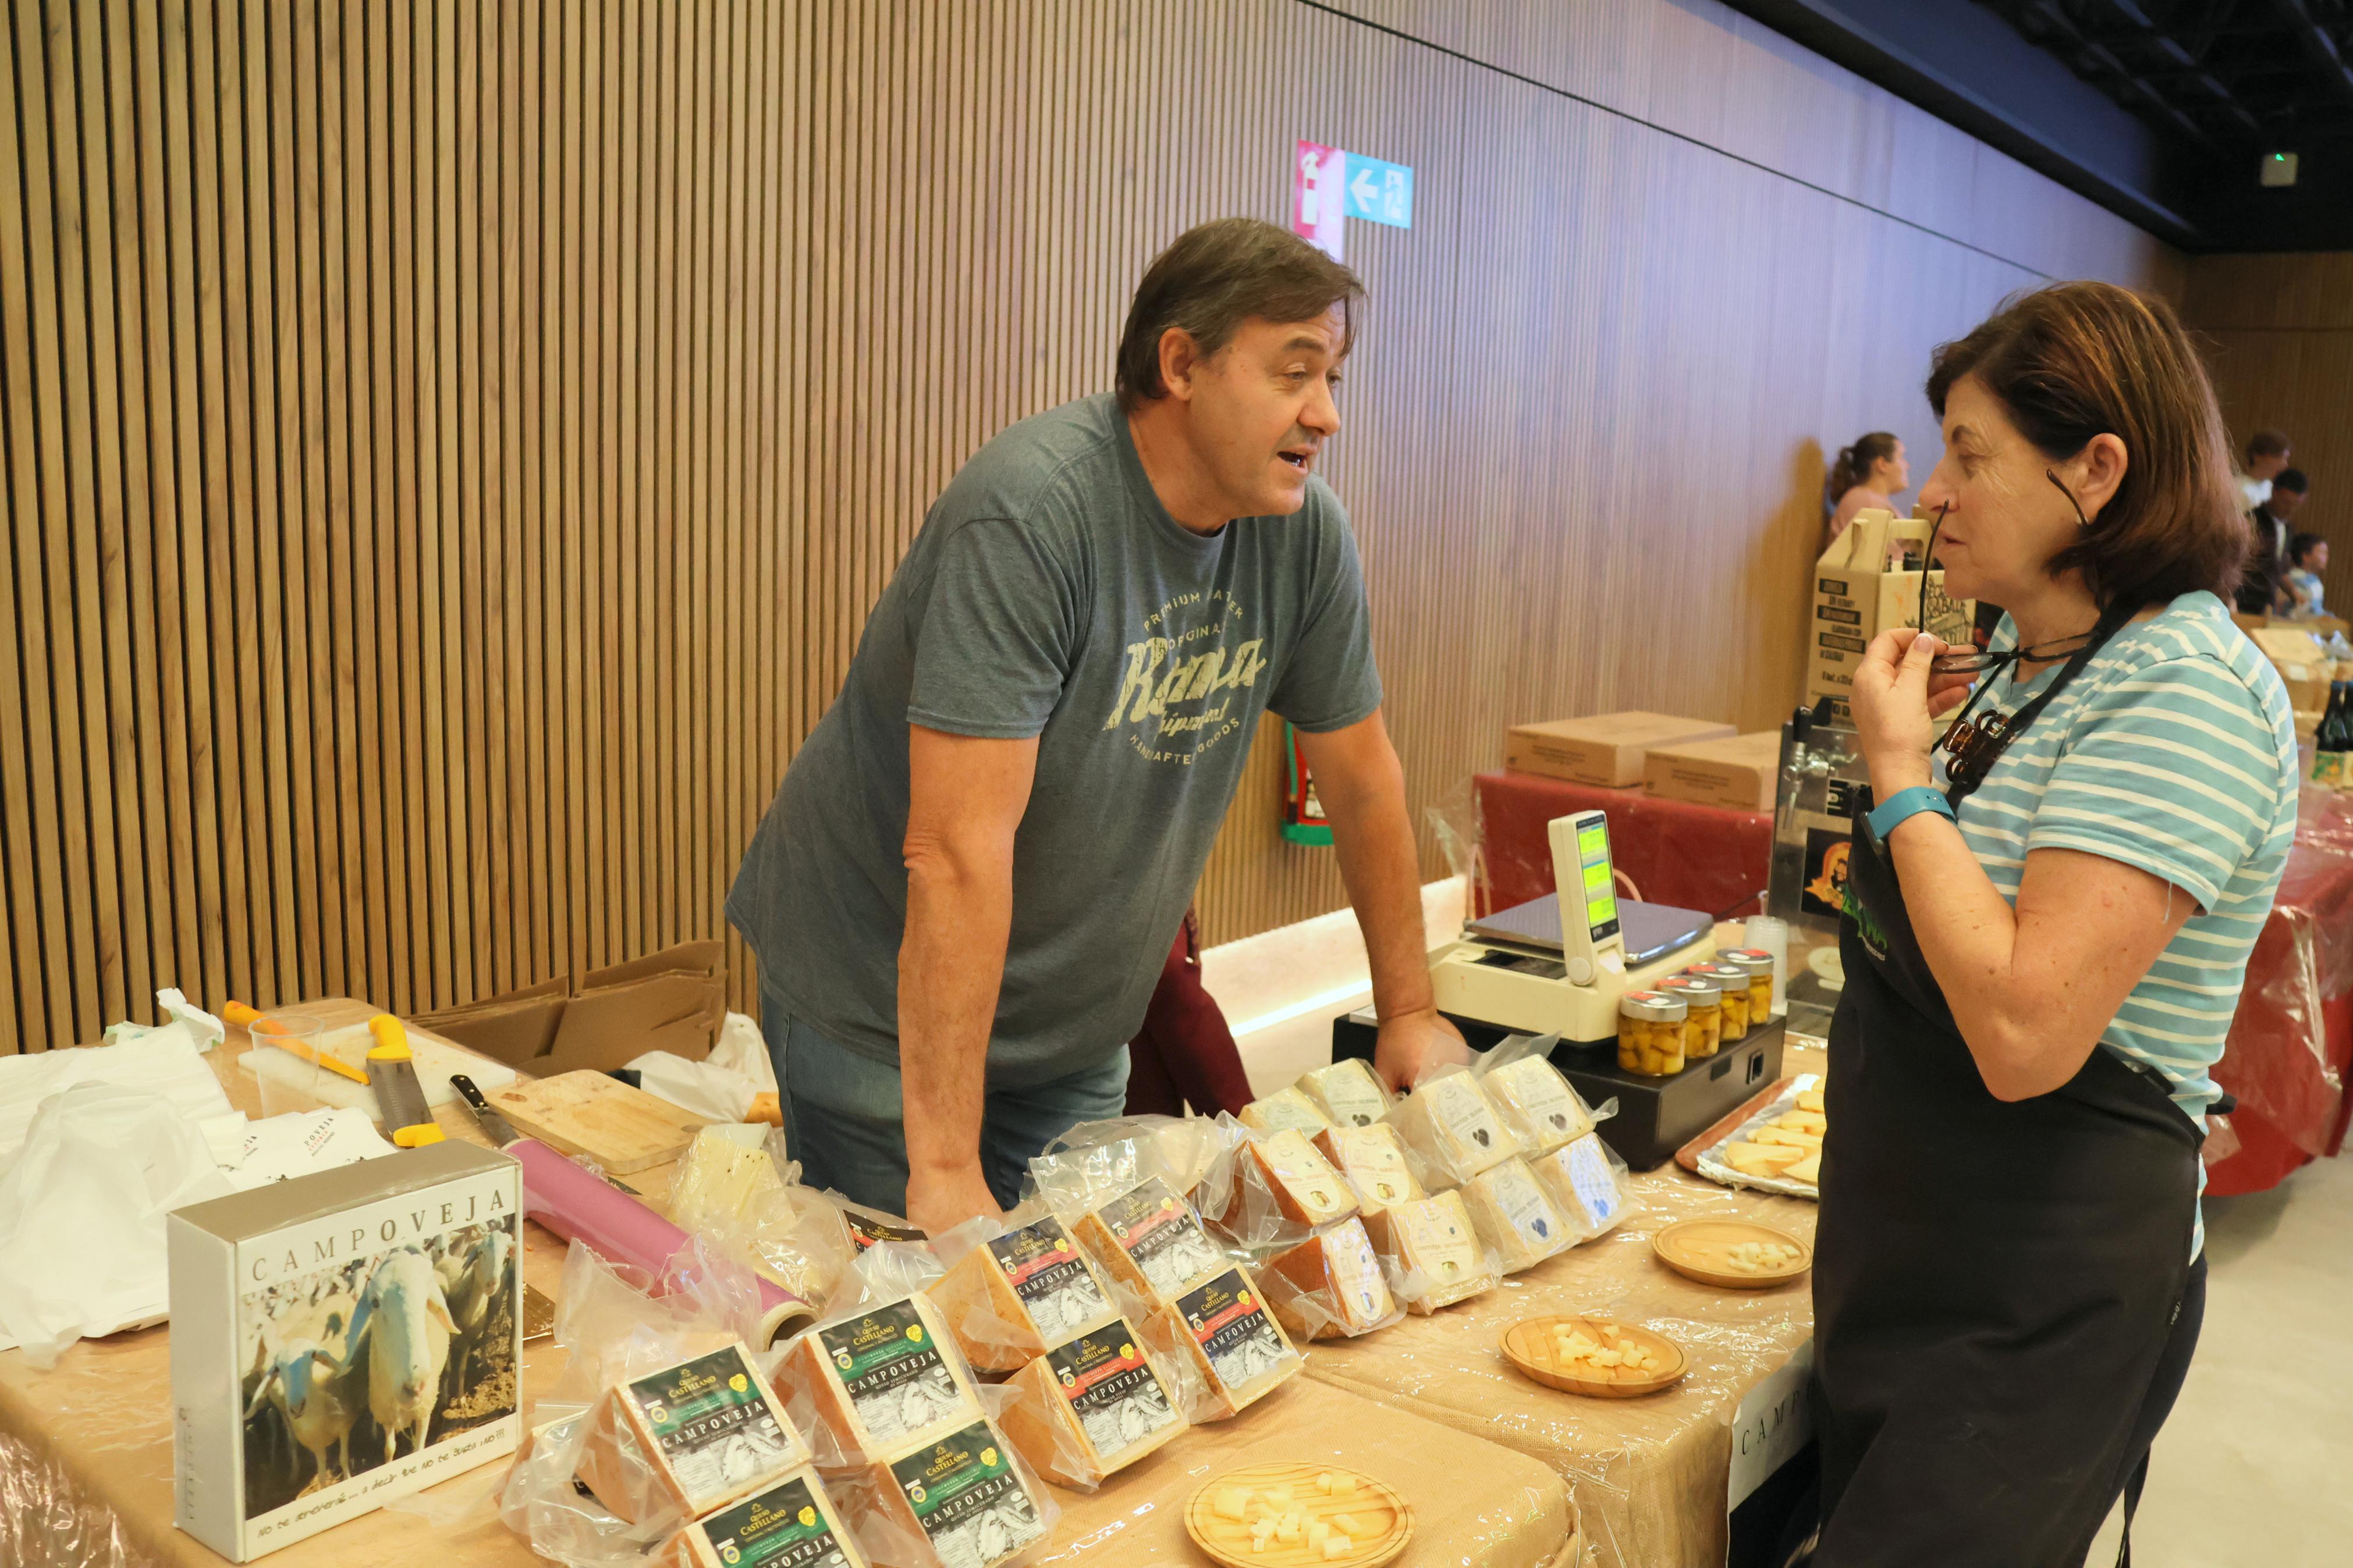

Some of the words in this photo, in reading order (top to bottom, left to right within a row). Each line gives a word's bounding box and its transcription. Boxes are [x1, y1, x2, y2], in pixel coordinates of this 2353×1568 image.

[1197, 717, 1240, 753] GOODS
[304, 1117, 334, 1146] POVEJA
[1124, 1201, 1151, 1219] CASTELLANO
[253, 1189, 504, 1281] CAMPOVEJA
[1015, 1239, 1045, 1256] CASTELLANO
[1131, 1217, 1189, 1257] CAMPOVEJA
[1018, 1261, 1081, 1296] CAMPOVEJA
[1201, 1292, 1229, 1311] CASTELLANO
[853, 1325, 895, 1346] CASTELLANO
[861, 1324, 879, 1335] QUESO
[1205, 1313, 1264, 1352] CAMPOVEJA
[1076, 1345, 1109, 1364] CASTELLANO
[1082, 1345, 1096, 1355] QUESO
[848, 1350, 936, 1393] CAMPOVEJA
[668, 1375, 716, 1398] CASTELLANO
[1074, 1368, 1148, 1410] CAMPOVEJA
[662, 1401, 764, 1449] CAMPOVEJA
[926, 1451, 968, 1477] CASTELLANO
[935, 1451, 953, 1464] QUESO
[277, 1519, 289, 1528] te
[372, 1474, 397, 1490] decir
[438, 1453, 449, 1463] te
[923, 1474, 1013, 1528] CAMPOVEJA
[740, 1509, 786, 1535] CASTELLANO
[771, 1535, 832, 1568] POVEJA
